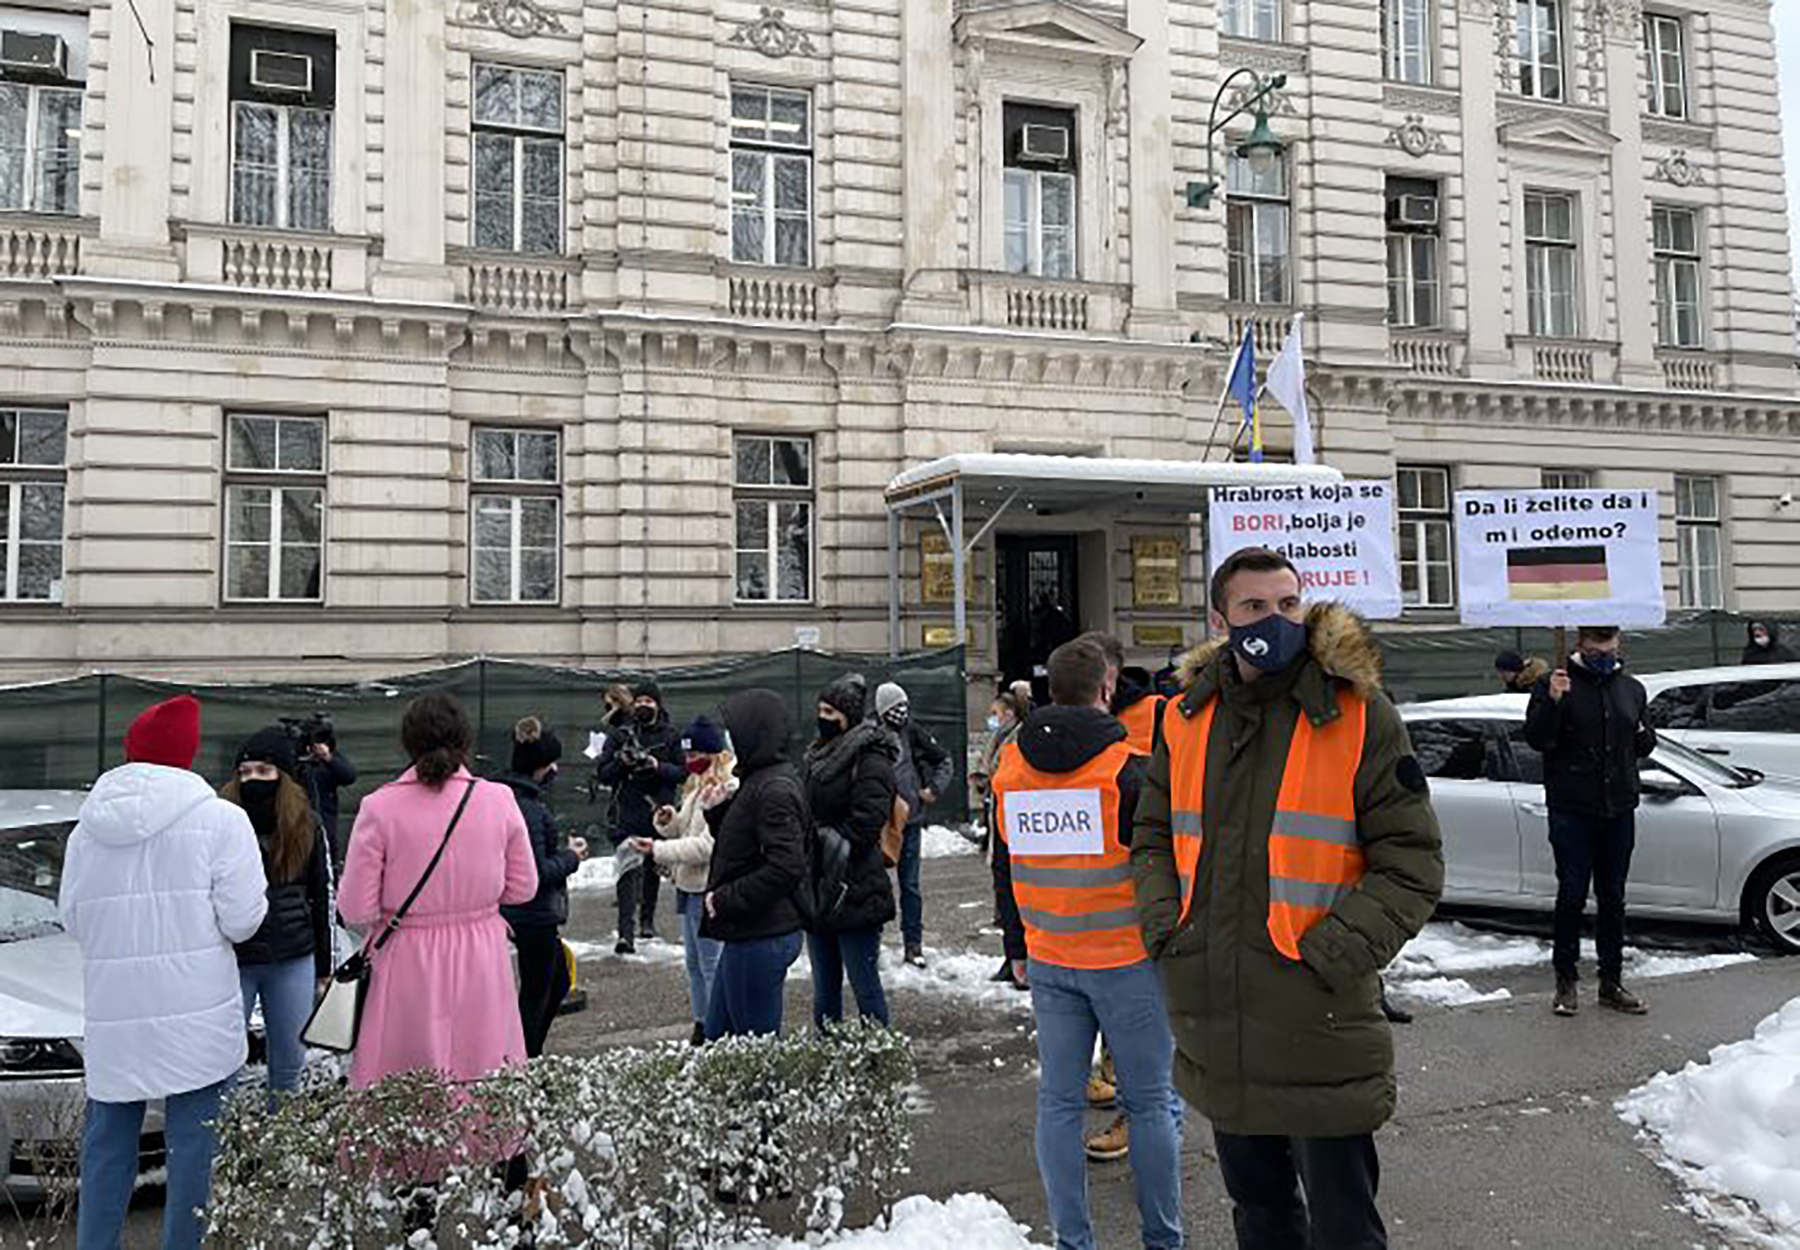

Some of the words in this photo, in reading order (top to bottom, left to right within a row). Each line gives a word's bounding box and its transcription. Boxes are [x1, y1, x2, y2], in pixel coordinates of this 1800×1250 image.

[1213, 485, 1304, 502] Hrabrost
[1310, 484, 1353, 503] koja
[1360, 484, 1384, 498] se
[1465, 500, 1495, 516] Da
[1504, 498, 1517, 514] li
[1602, 494, 1632, 510] da
[1641, 492, 1647, 509] i
[1347, 511, 1366, 531] je
[1530, 522, 1628, 541] odemo?
[1276, 541, 1358, 559] slabosti
[1302, 570, 1357, 587] RUJE
[1017, 810, 1091, 833] REDAR
